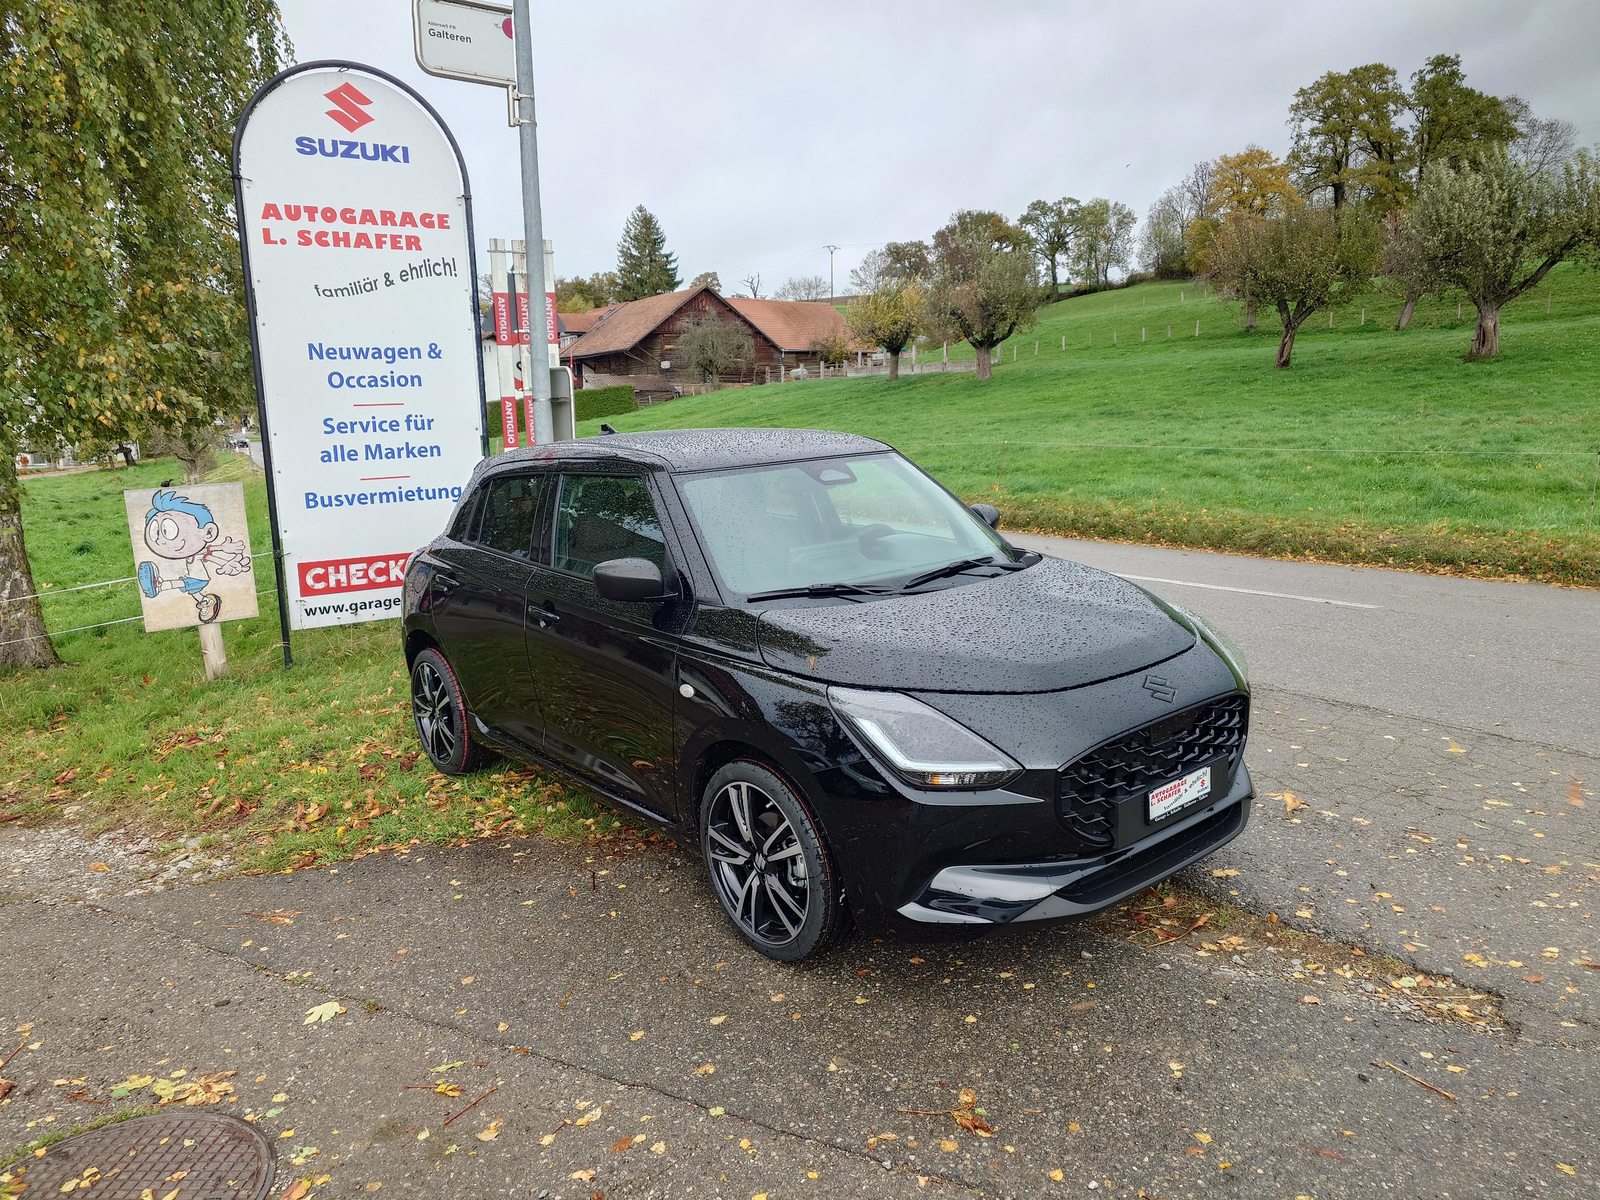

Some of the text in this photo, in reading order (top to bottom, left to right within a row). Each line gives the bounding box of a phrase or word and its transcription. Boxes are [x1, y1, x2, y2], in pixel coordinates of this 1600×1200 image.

[428, 28, 472, 43] Galteren
[295, 136, 410, 164] SUZUKI
[261, 203, 450, 230] AUTOGARAGE
[262, 228, 423, 251] L. SCHAFER
[314, 257, 458, 298] familiär & ehrlich!
[498, 296, 508, 341] ANTIGLIO
[307, 342, 443, 364] Neuwagen &
[327, 370, 423, 389] Occasion
[322, 414, 434, 435] Service für
[505, 400, 515, 444] ANTIGLIO
[320, 441, 442, 464] alle Marken
[304, 485, 462, 509] Busvermietung
[305, 558, 406, 590] CHECK
[1150, 778, 1188, 801] AUTOGARAGE
